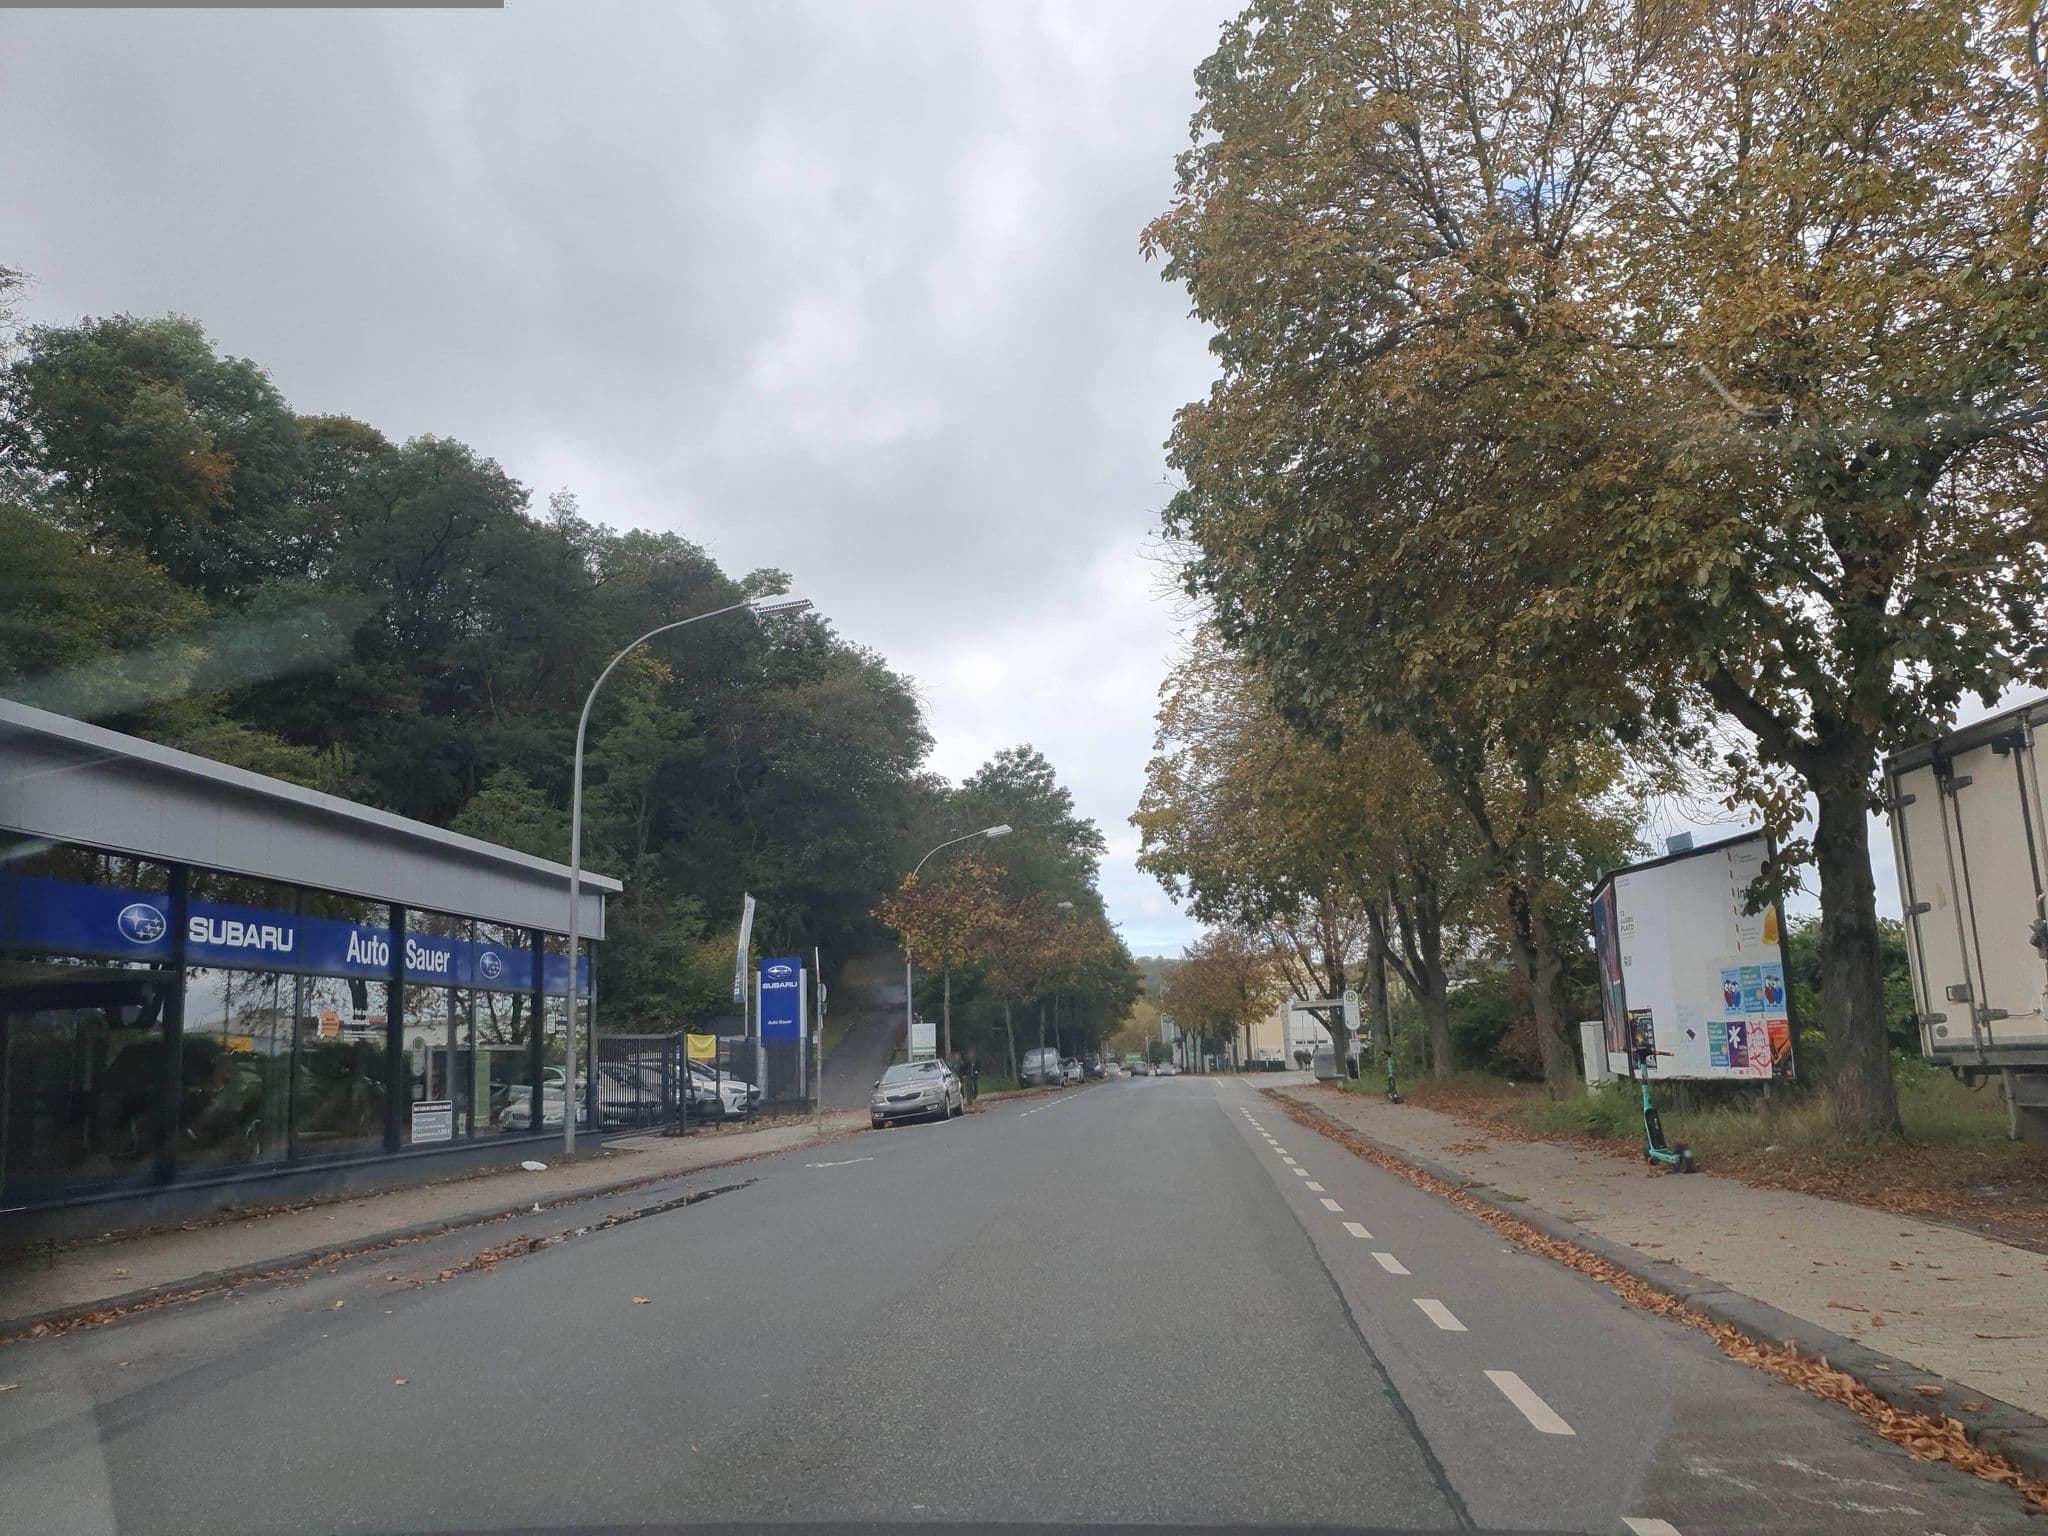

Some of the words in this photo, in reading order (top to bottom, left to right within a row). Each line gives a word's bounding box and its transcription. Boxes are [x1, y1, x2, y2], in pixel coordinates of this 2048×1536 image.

[189, 916, 293, 952] SUBARU
[346, 930, 390, 966] Auto
[404, 939, 450, 972] Sauer
